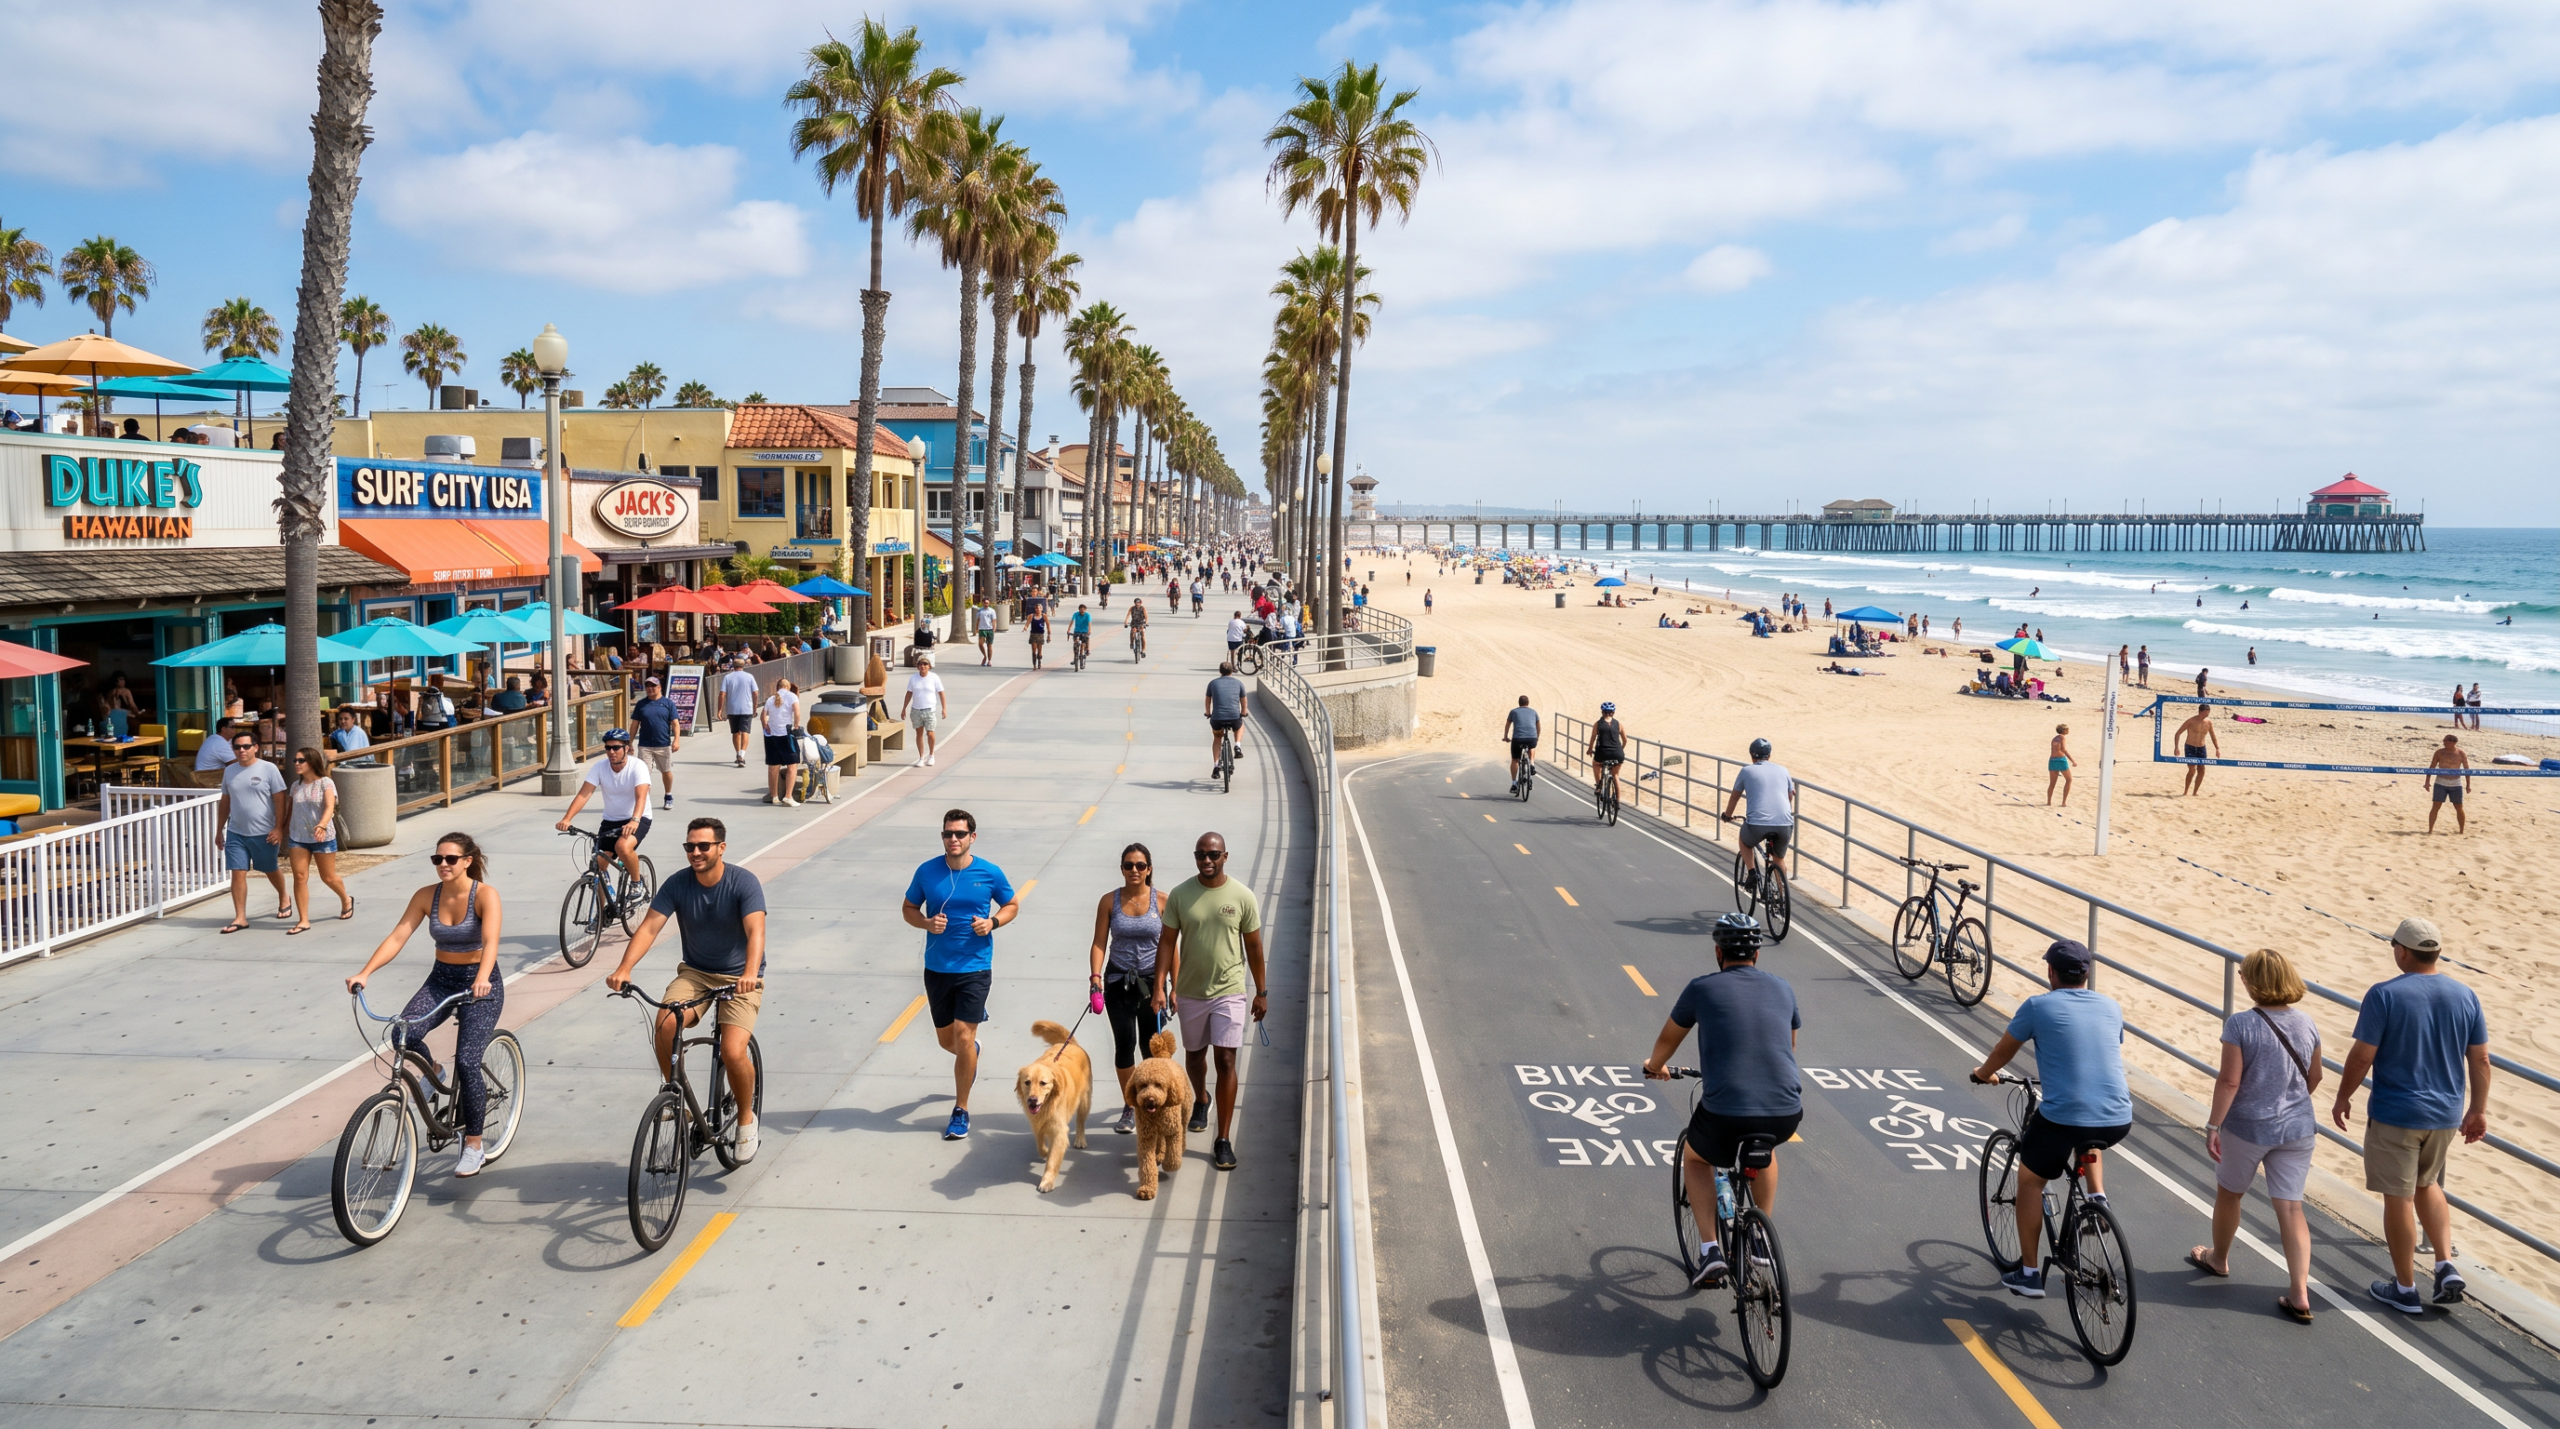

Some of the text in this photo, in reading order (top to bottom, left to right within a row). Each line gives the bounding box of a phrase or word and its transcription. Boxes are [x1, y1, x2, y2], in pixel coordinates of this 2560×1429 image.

[43, 455, 203, 508] DUKE'S
[353, 468, 533, 509] SURF CITY USA
[614, 490, 675, 516] JACK'S
[1514, 1065, 1645, 1087] BIKE
[1802, 1067, 1944, 1091] BIKE
